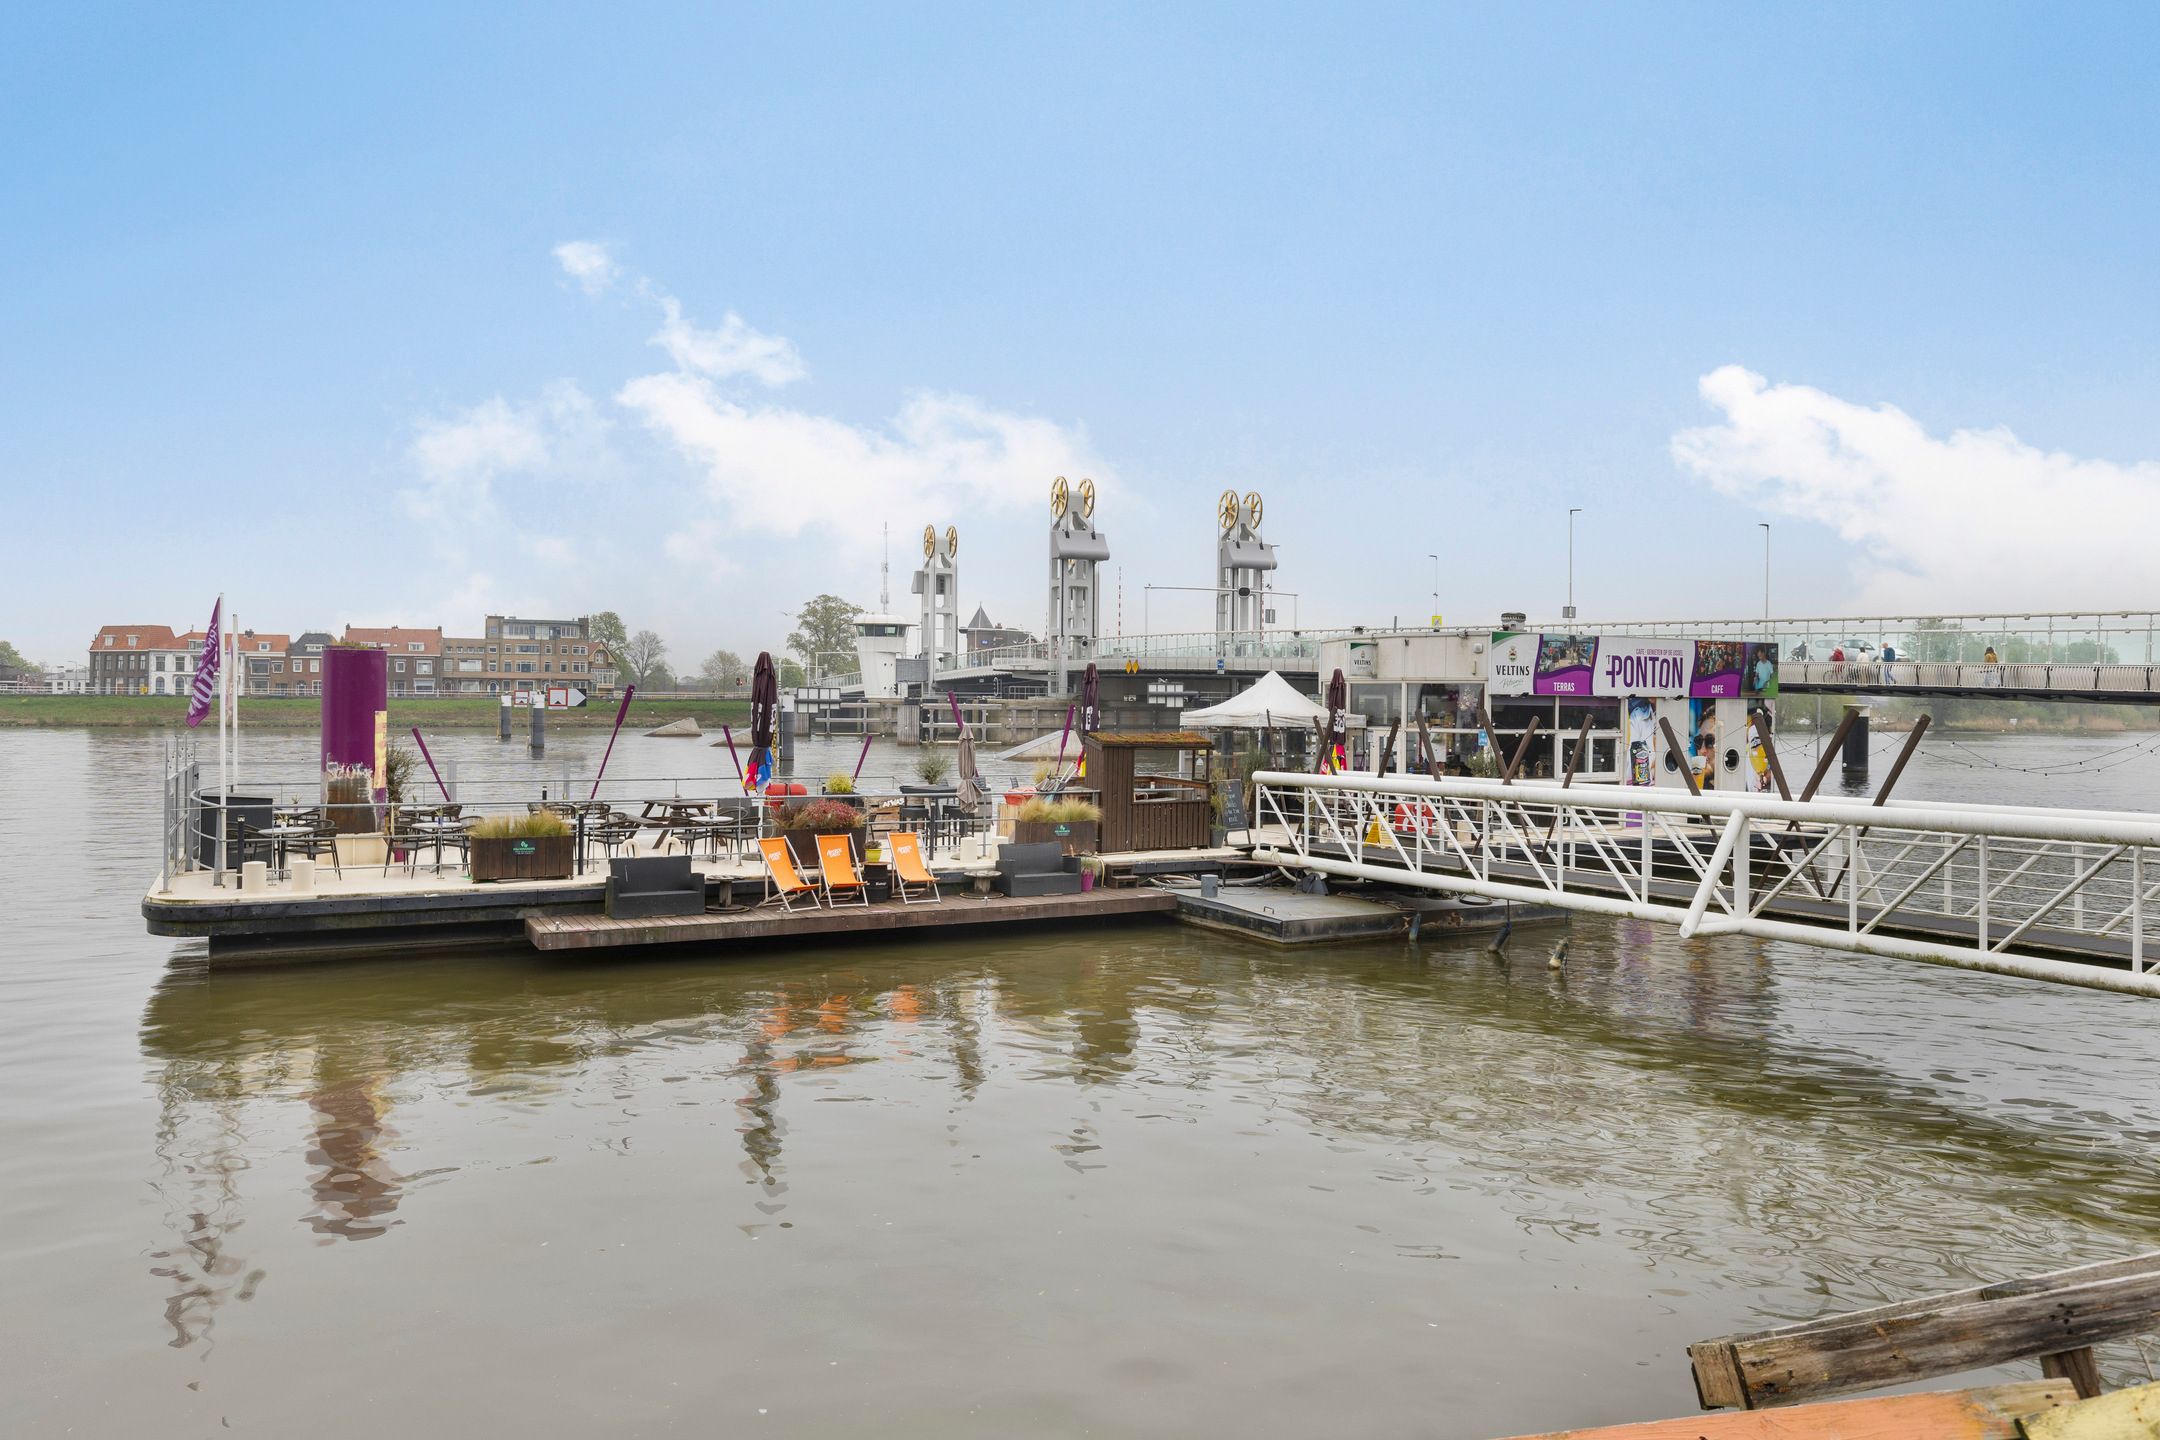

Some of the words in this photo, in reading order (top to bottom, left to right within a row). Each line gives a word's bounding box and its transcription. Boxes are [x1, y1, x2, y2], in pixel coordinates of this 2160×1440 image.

[1496, 664, 1530, 676] VELTINS
[1606, 655, 1684, 690] PONTON
[1553, 682, 1575, 692] TERRAS
[1711, 684, 1724, 694] CAFE
